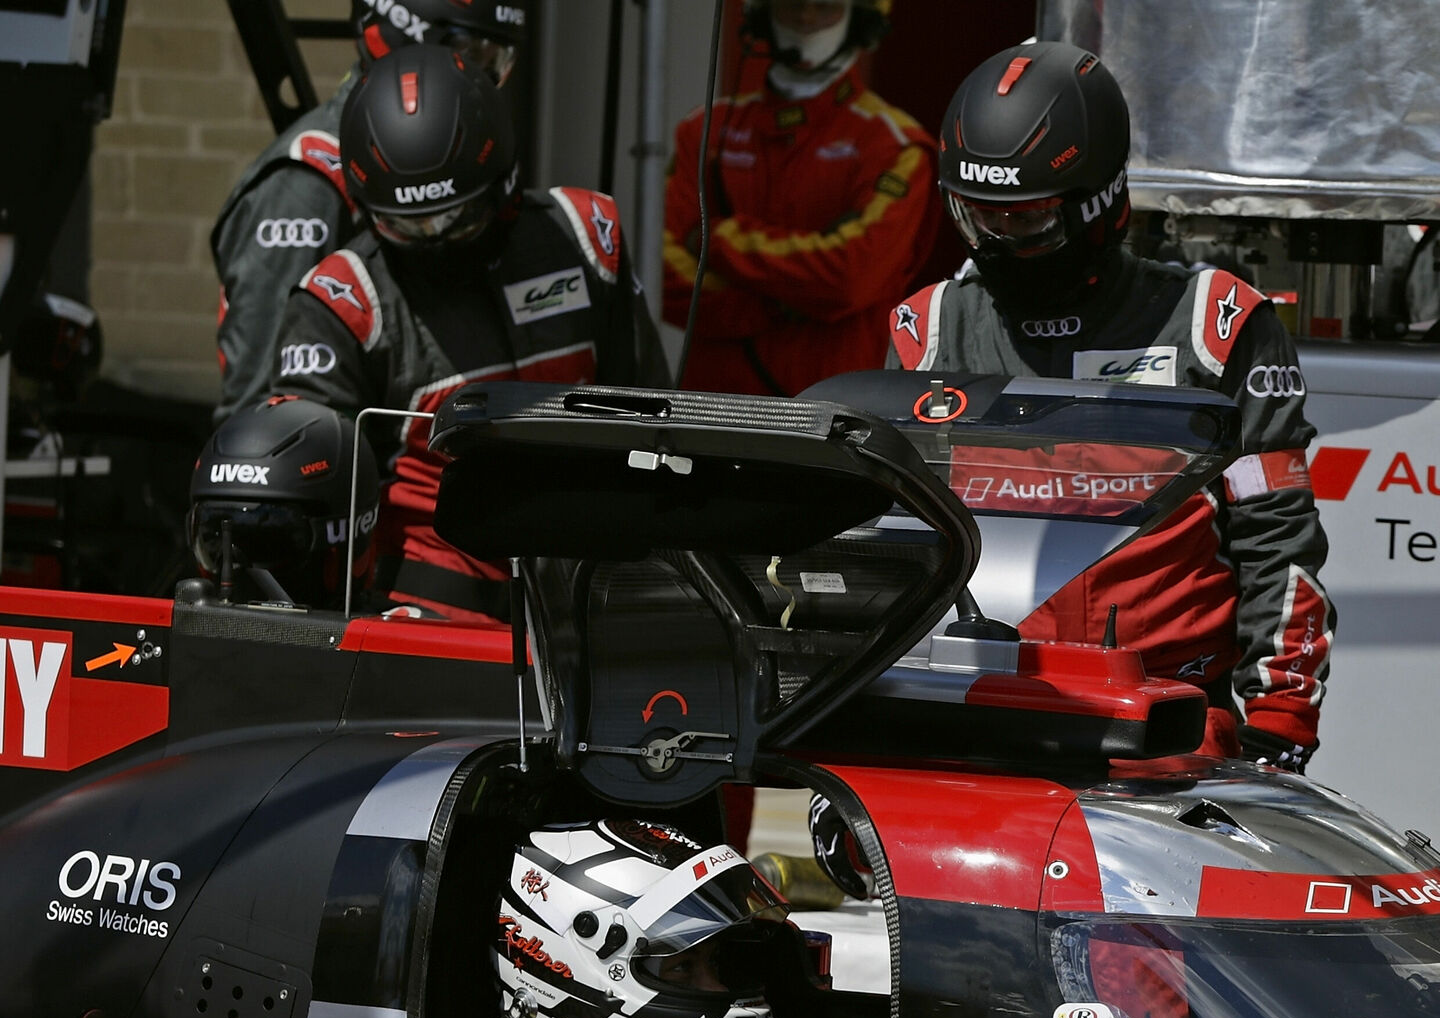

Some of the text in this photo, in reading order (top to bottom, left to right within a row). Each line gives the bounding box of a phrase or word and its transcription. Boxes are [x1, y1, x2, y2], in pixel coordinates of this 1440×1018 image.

[1050, 144, 1079, 169] uvex
[959, 160, 1022, 187] uvex
[394, 178, 457, 204] uvex
[1079, 160, 1130, 224] uve
[210, 463, 270, 486] uvex
[301, 460, 329, 476] uvex
[996, 473, 1157, 500] Audi Sport
[0, 636, 68, 758] Y
[708, 849, 738, 867] Audi
[58, 849, 182, 912] ORIS
[46, 900, 169, 940] Swiss Watches
[505, 923, 575, 980] Lotterer
